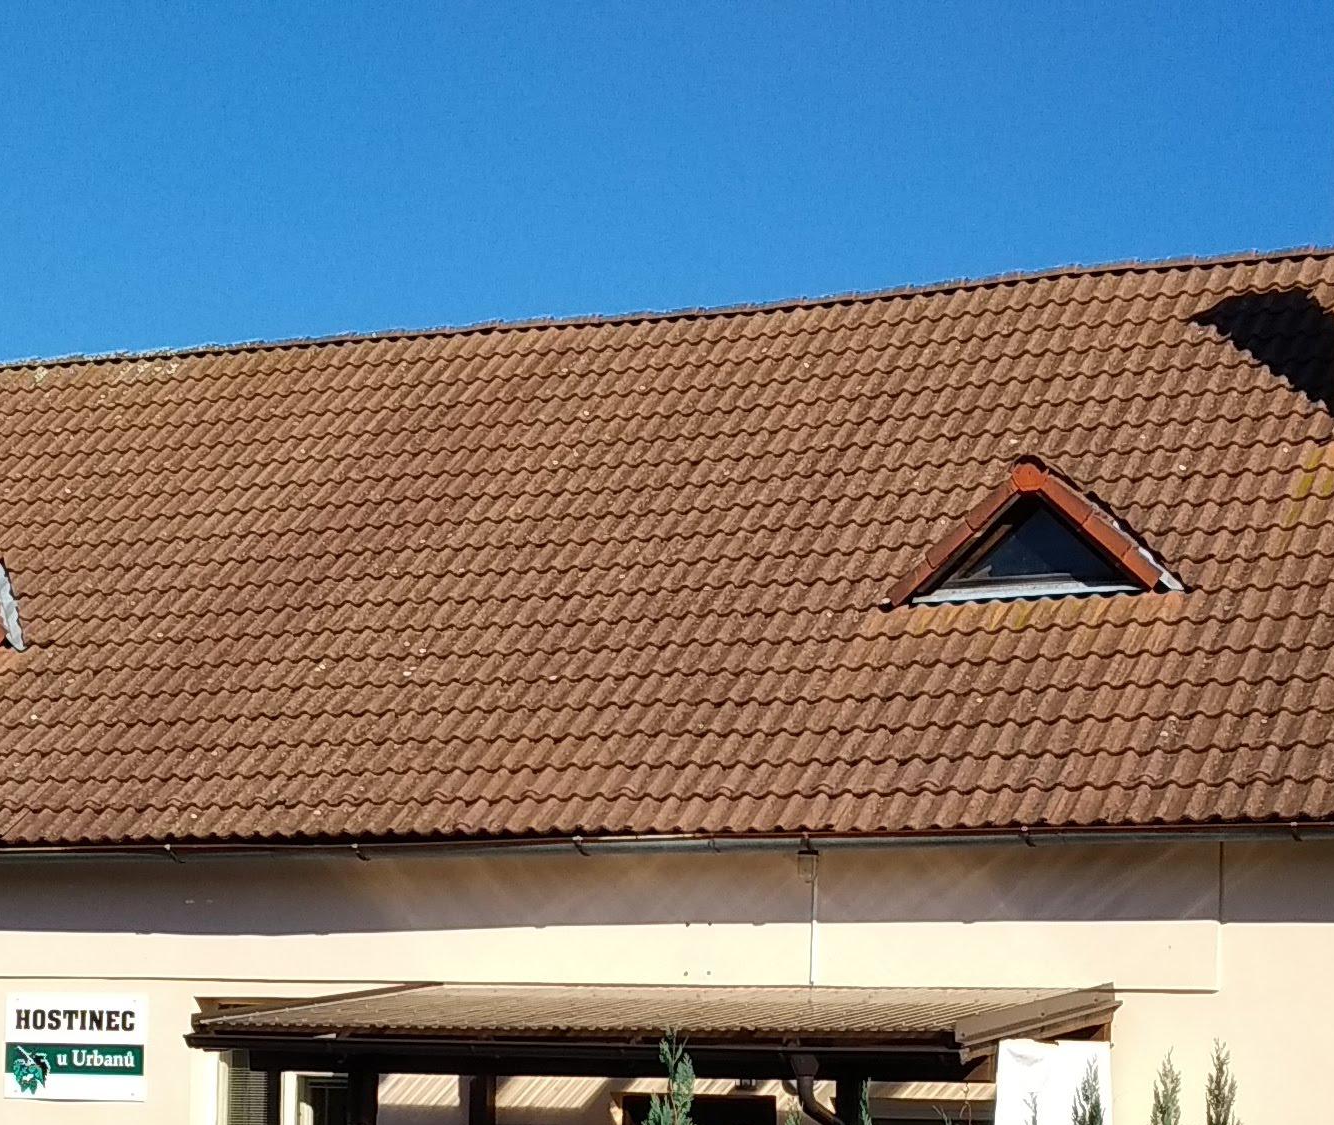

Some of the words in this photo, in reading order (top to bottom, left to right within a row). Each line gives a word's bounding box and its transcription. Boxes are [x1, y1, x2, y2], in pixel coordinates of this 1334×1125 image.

[15, 1008, 136, 1032] HOSTINEC
[56, 1053, 68, 1066] u
[72, 1049, 136, 1068] Urbanů
